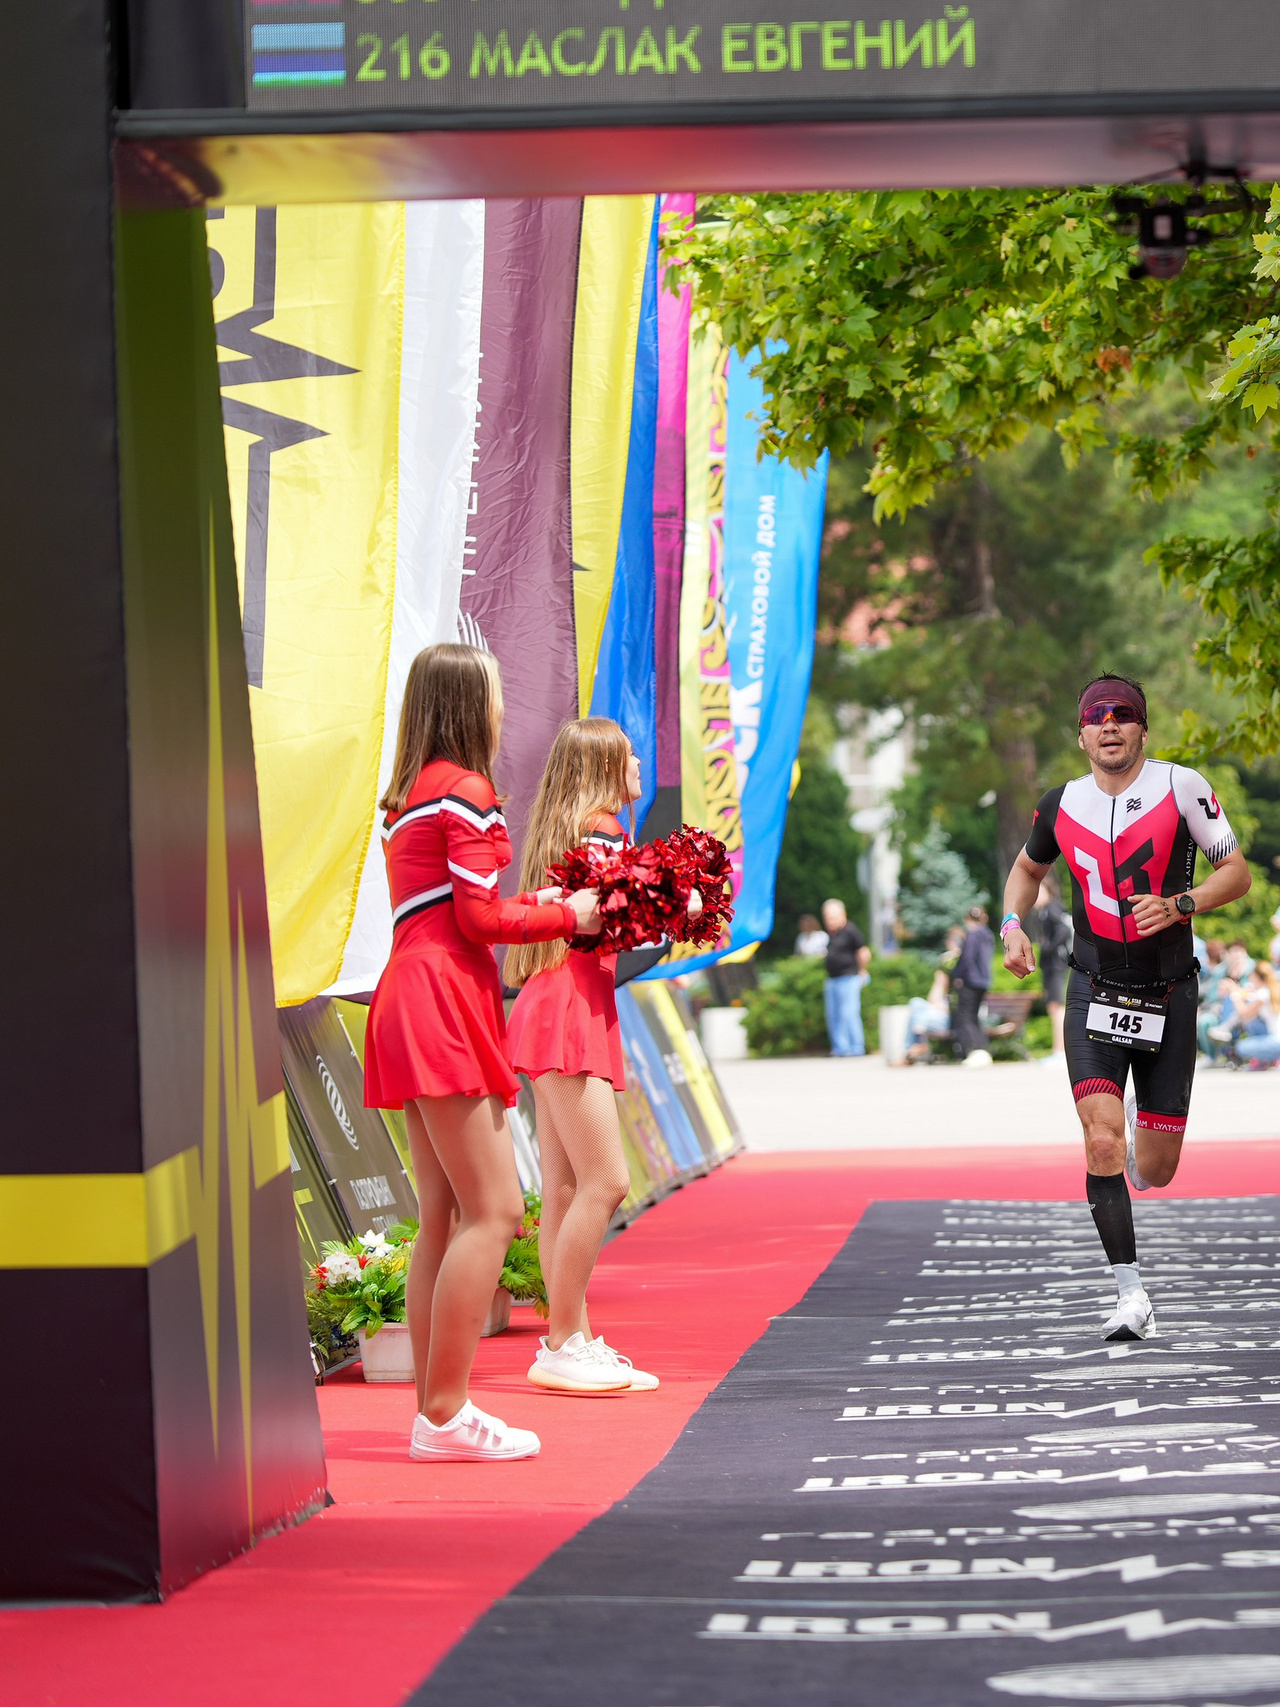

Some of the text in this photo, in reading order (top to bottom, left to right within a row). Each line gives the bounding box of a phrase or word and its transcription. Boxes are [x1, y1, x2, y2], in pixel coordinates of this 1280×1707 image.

[355, 33, 450, 83] 216
[470, 26, 703, 79] МАСЛАК
[721, 5, 976, 73] ЕВГЕНИЙ
[746, 495, 776, 680] СТРАХОВОЙ ДОМ
[1109, 1012, 1143, 1035] 145
[1111, 1035, 1133, 1045] GALSAN
[869, 1346, 1065, 1362] IRON
[843, 1402, 1066, 1417] IRON
[802, 1469, 1062, 1488] IRON
[744, 1557, 1053, 1577] IRON
[707, 1611, 1050, 1634] IRON
